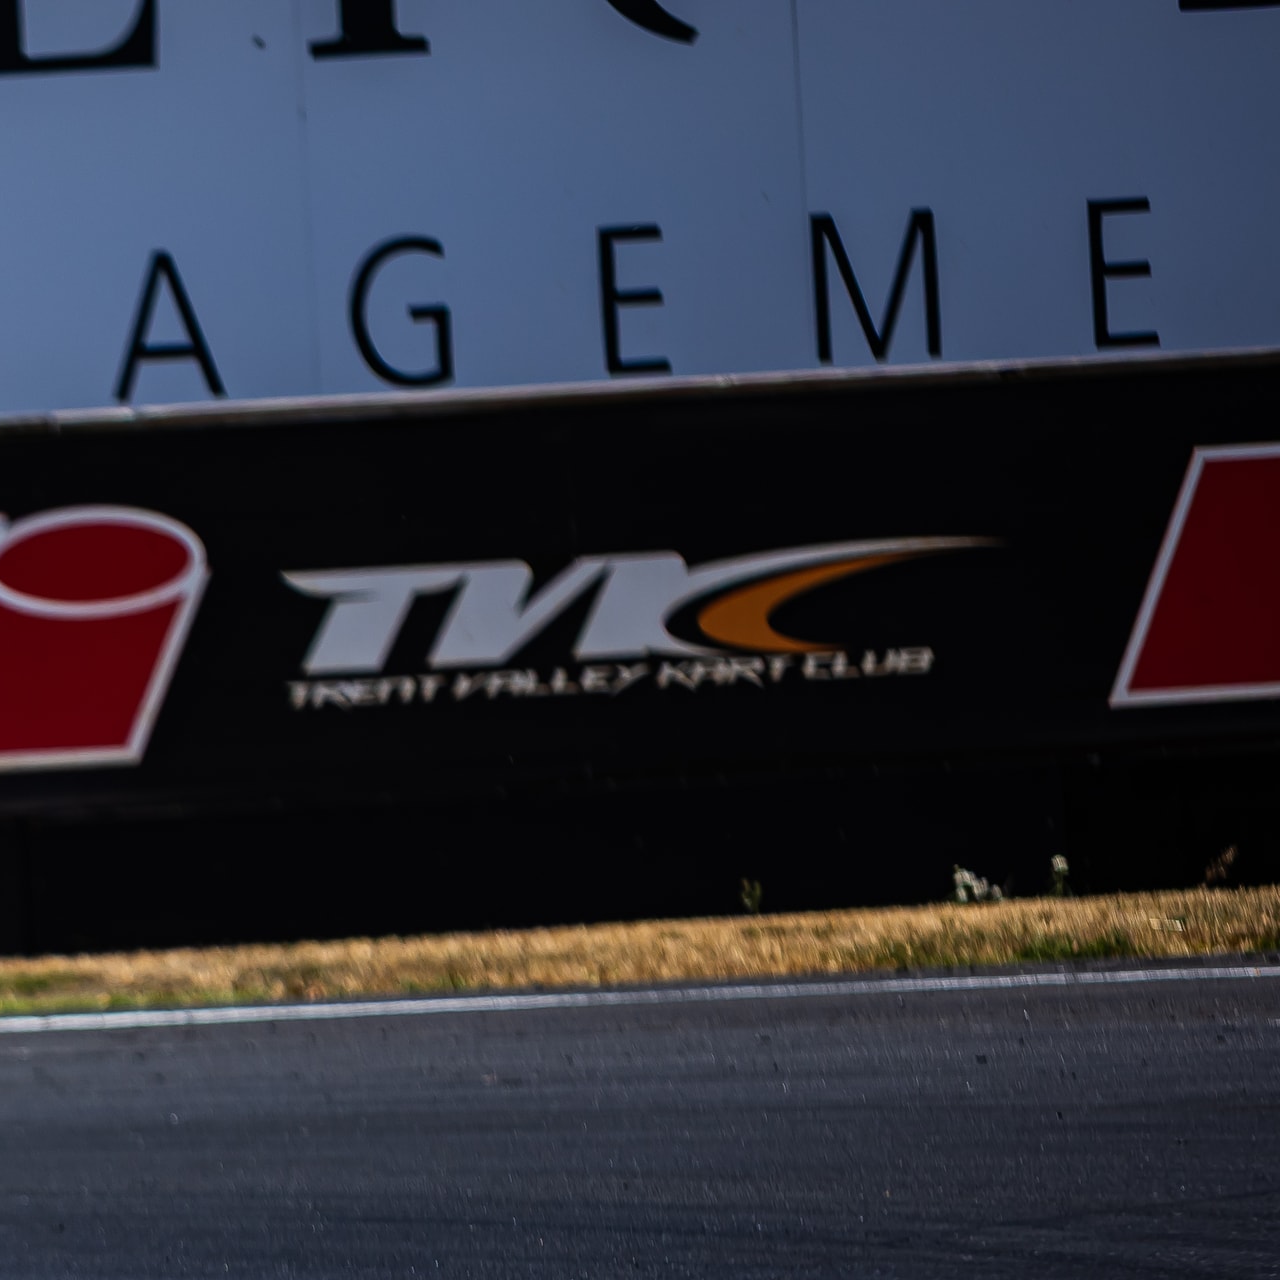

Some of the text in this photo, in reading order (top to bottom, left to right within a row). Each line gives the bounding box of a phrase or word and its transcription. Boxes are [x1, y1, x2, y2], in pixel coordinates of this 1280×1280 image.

[450, 662, 654, 701] VALLEY
[657, 653, 794, 694] KART
[800, 645, 935, 683] CLUB
